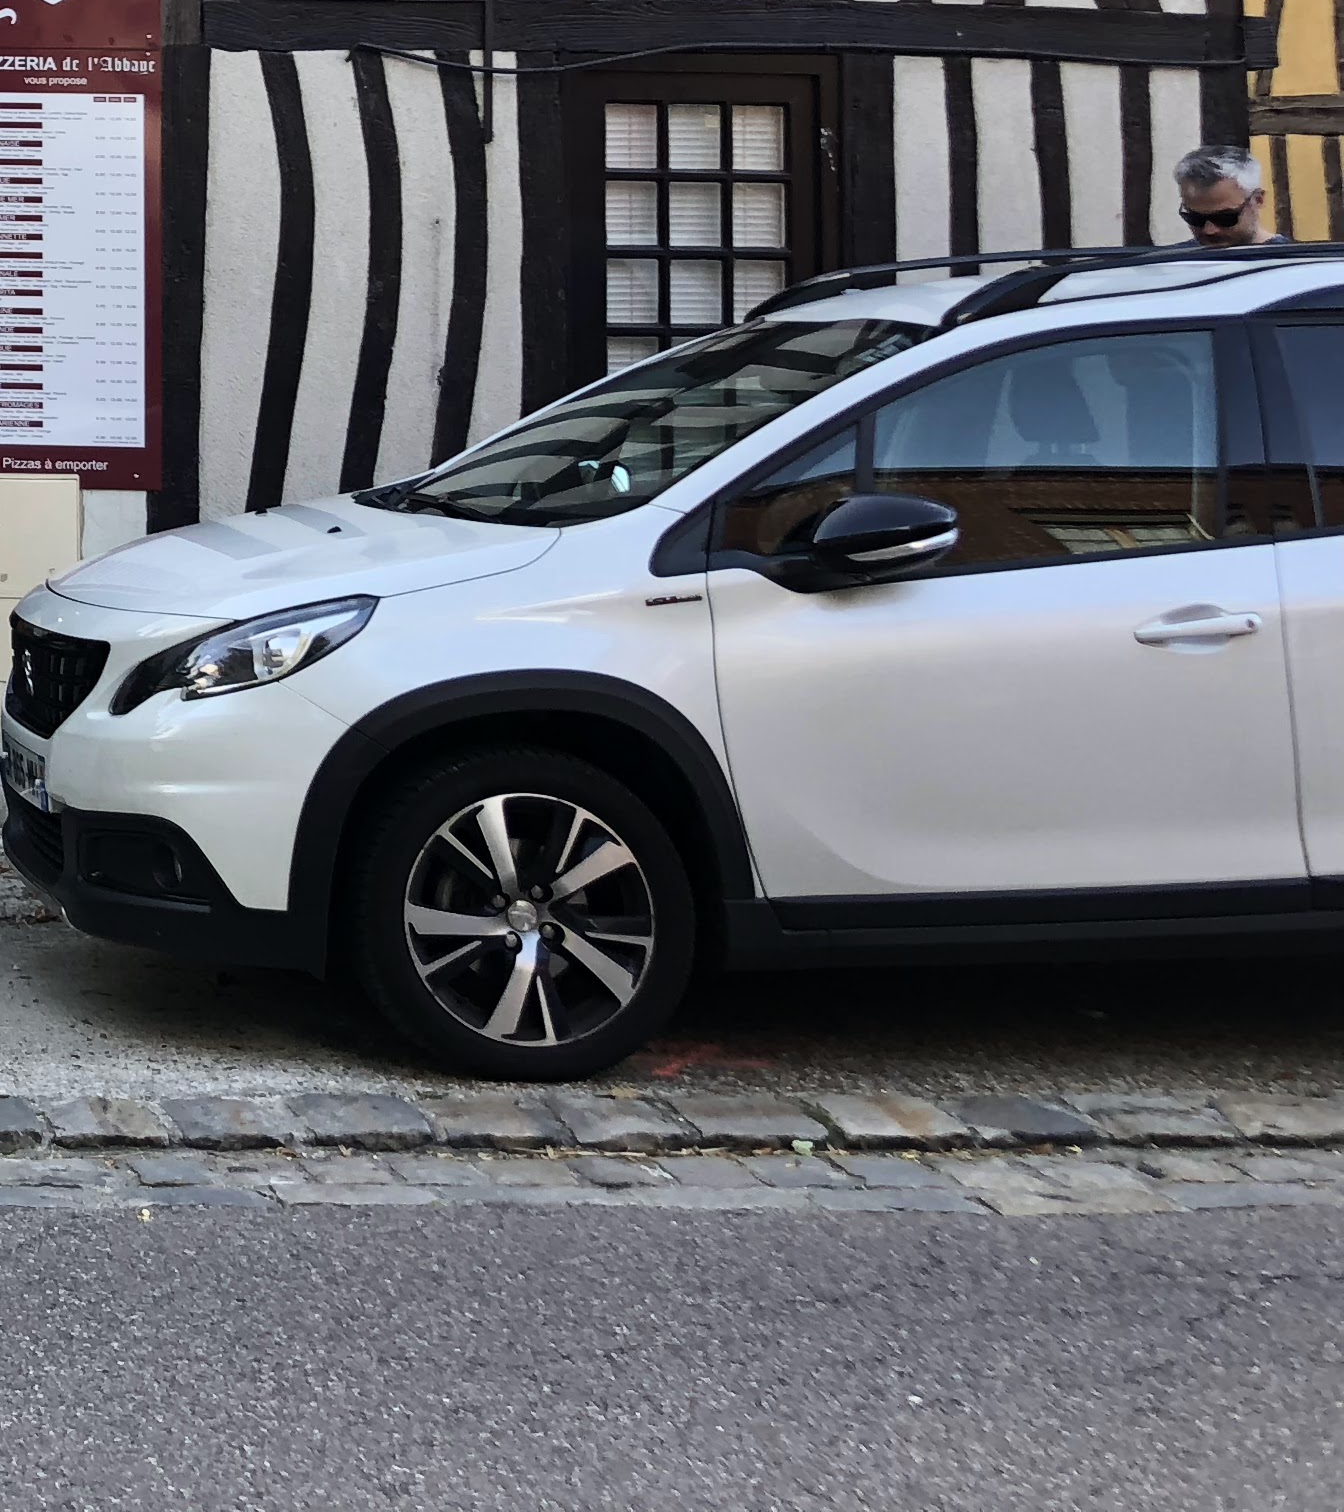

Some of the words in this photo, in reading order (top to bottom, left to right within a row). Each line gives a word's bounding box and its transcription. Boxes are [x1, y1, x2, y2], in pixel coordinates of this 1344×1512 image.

[62, 56, 80, 71] de
[88, 56, 156, 75] l'Abbaye
[23, 76, 47, 85] vous
[48, 77, 88, 87] propose
[2, 457, 42, 469] Pizzas
[44, 458, 52, 470] à
[54, 460, 109, 472] emporter
